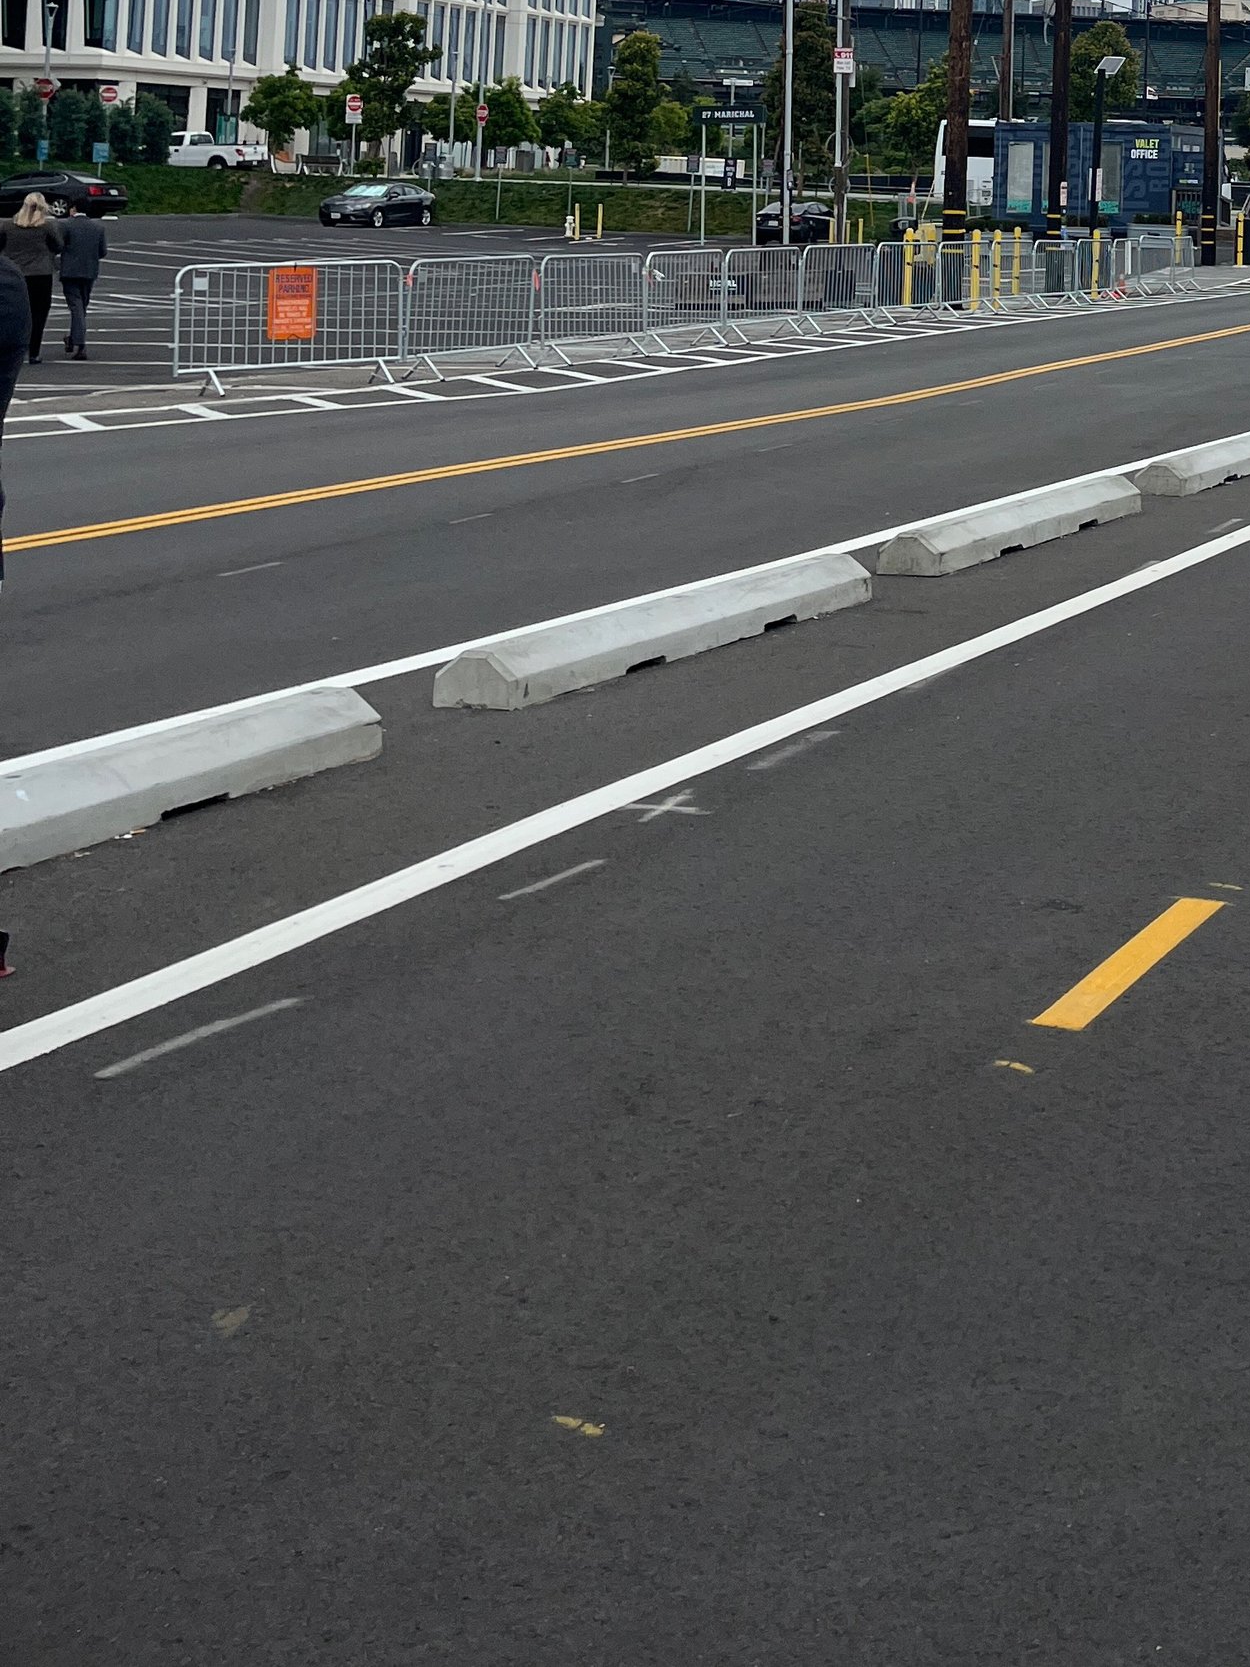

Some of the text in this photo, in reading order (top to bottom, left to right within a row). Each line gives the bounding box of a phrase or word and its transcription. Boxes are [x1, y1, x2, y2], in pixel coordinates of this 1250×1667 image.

[714, 110, 755, 119] MARICHAL
[1135, 139, 1160, 149] VALET
[1130, 149, 1159, 160] OFFICE
